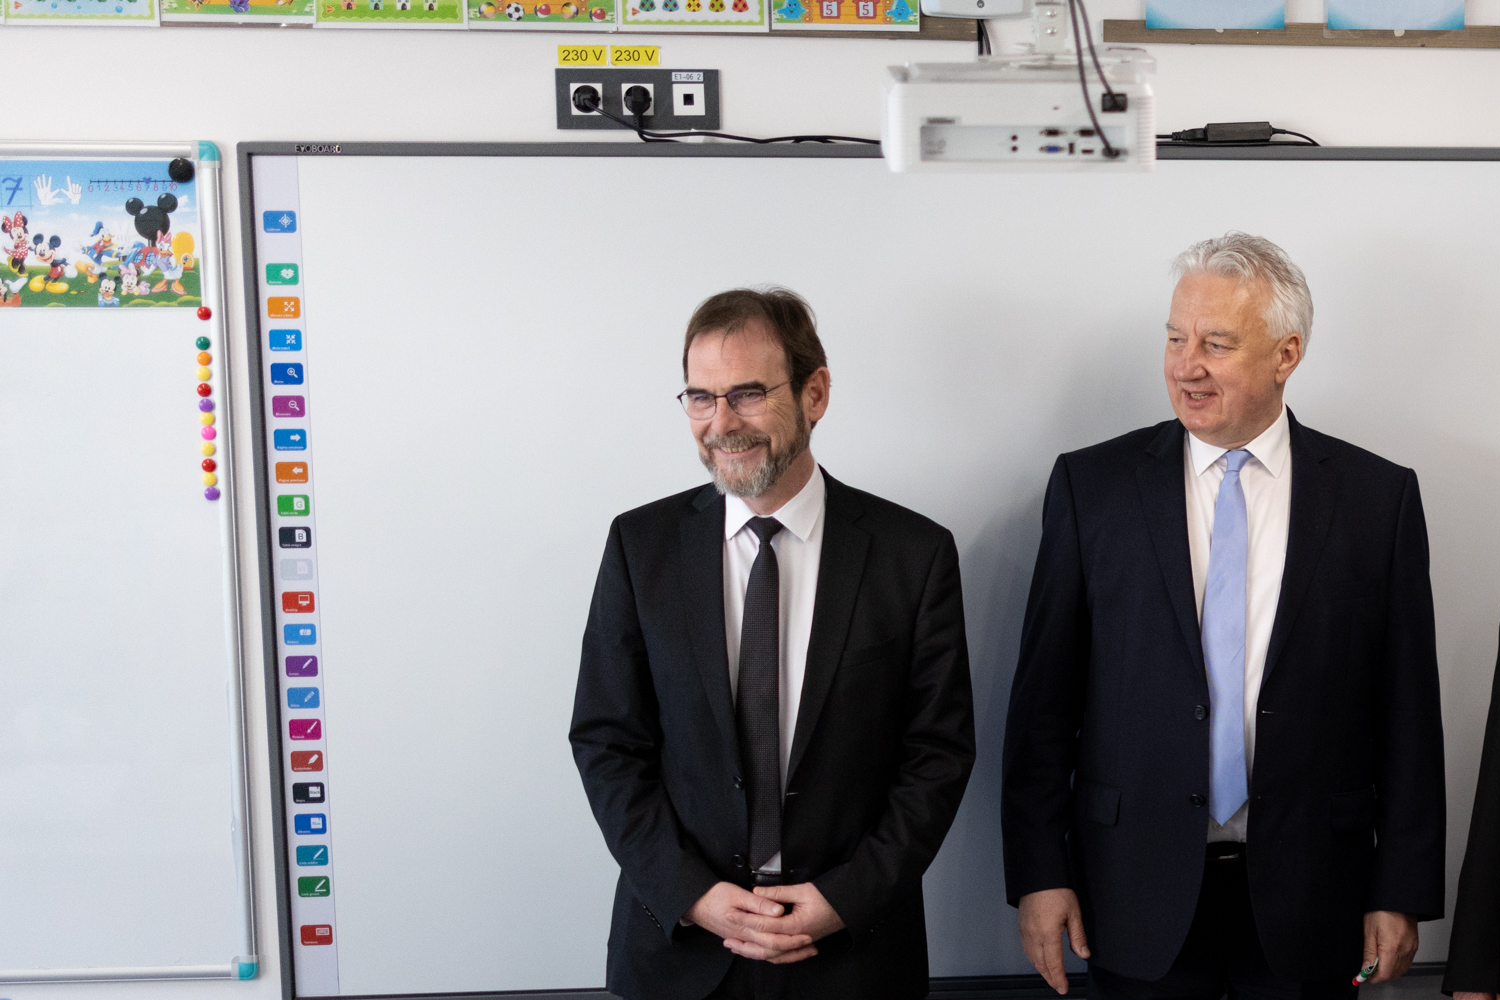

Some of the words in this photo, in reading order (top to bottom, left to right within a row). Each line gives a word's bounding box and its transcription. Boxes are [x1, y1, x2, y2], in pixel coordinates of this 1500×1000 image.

[826, 4, 833, 15] 5
[862, 4, 869, 15] 5
[562, 49, 588, 61] 230
[592, 49, 603, 61] V
[614, 49, 640, 61] 230
[644, 49, 655, 61] V
[294, 143, 342, 153] EVOBOARD
[1, 176, 24, 205] 7
[114, 184, 118, 192] 3
[136, 183, 142, 191] 6
[145, 183, 150, 191] 7
[153, 183, 158, 191] 8
[168, 183, 177, 191] 10
